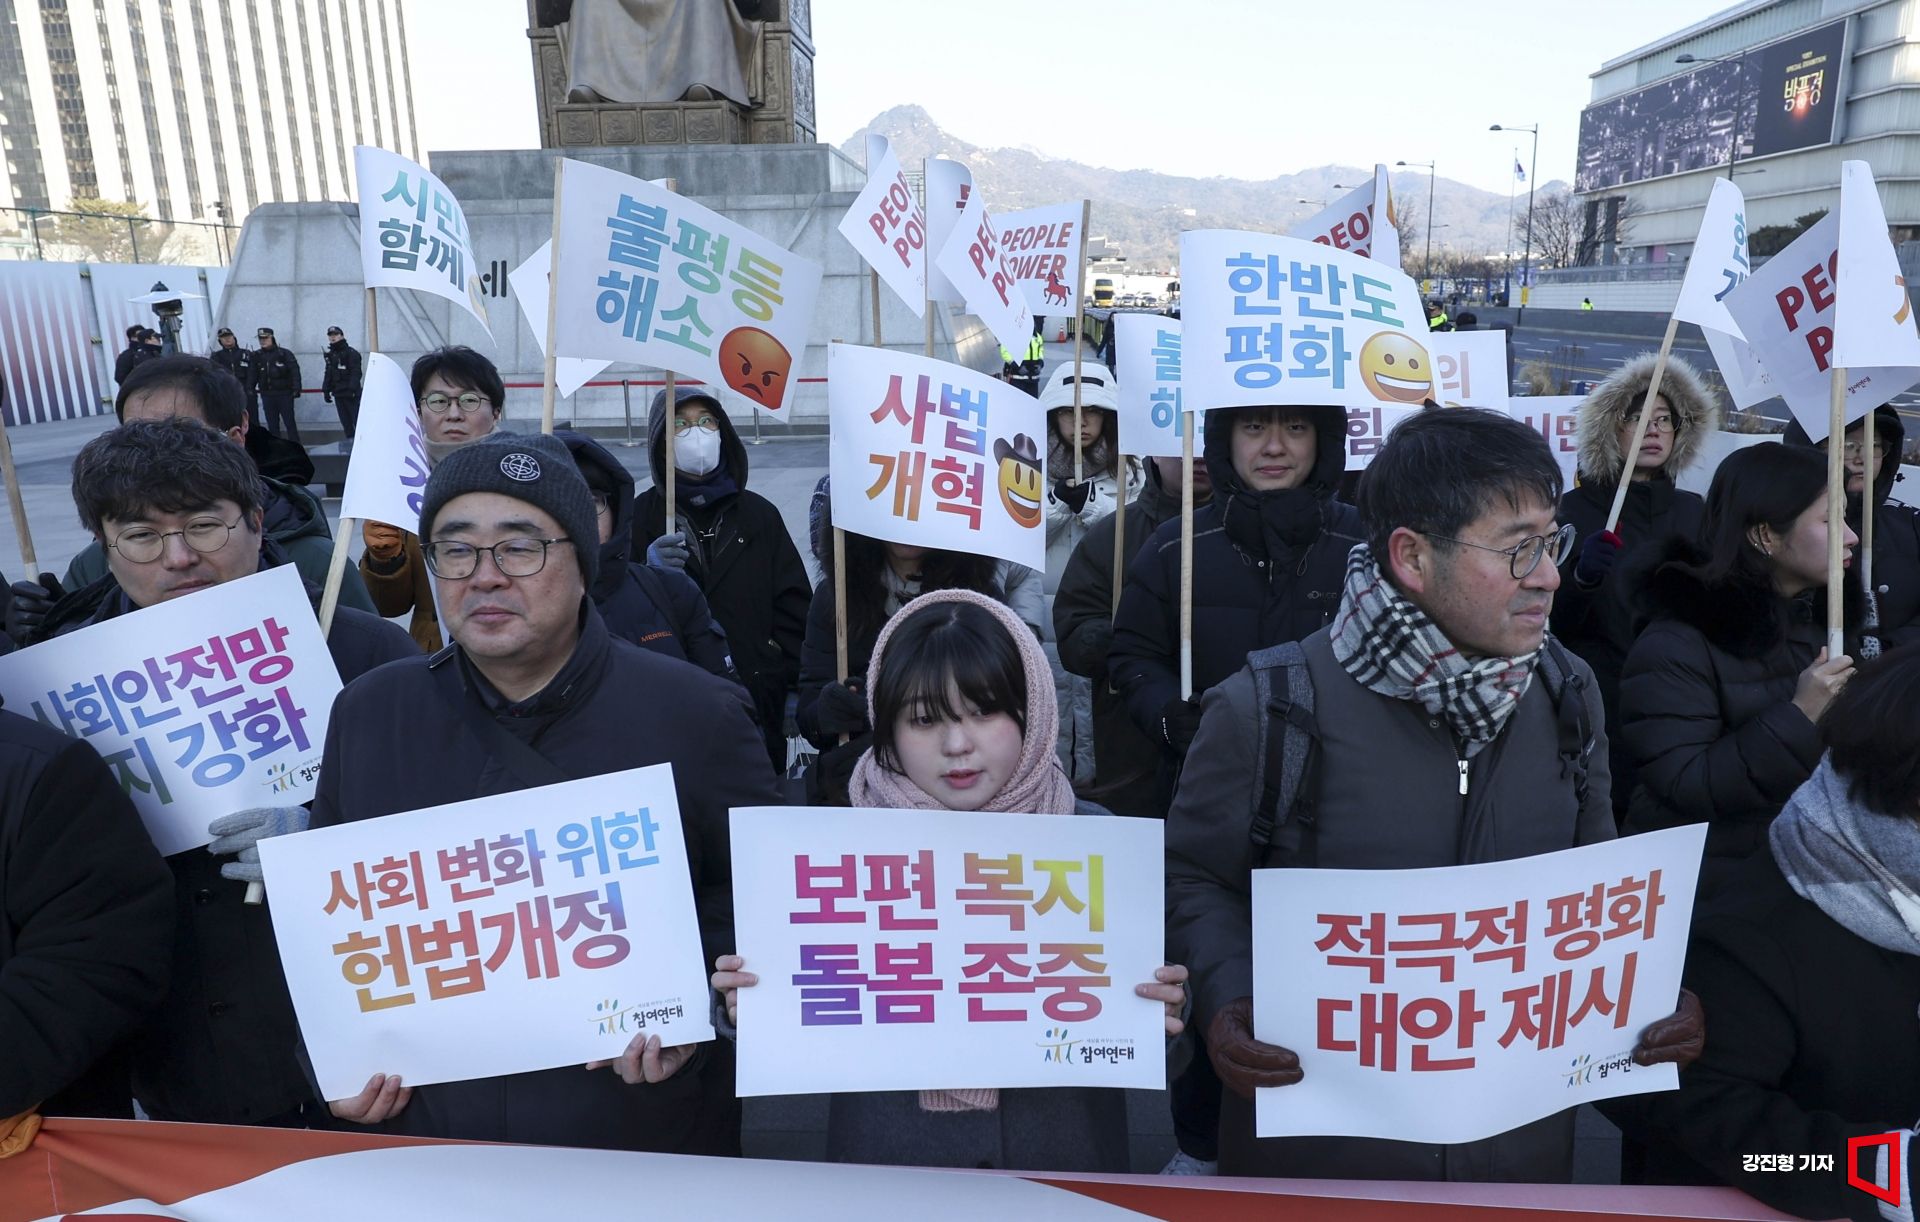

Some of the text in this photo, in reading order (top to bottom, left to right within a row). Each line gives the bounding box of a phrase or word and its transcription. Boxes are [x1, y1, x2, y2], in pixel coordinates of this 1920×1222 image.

[378, 217, 465, 293] 함께
[606, 193, 785, 322] 불평등
[1001, 222, 1074, 252] PEOPLE
[595, 269, 713, 358] 해소
[1225, 251, 1404, 329] 한반도
[1224, 322, 1351, 390] 평화
[869, 374, 989, 457] 사법
[865, 450, 983, 531] 개혁
[166, 686, 312, 788] 강화
[323, 806, 660, 921] 사회 변화 위한
[789, 850, 1105, 933] 보편 복지
[332, 881, 631, 1013] 헌법개정
[1314, 869, 1666, 984] 적극적 평화
[632, 1004, 684, 1029] 참여연대
[792, 942, 1111, 1026] 돌봄 존중
[1316, 951, 1638, 1073] 대안 제시
[1080, 1046, 1135, 1064] 참여연대
[1598, 1056, 1634, 1078] 참여연
